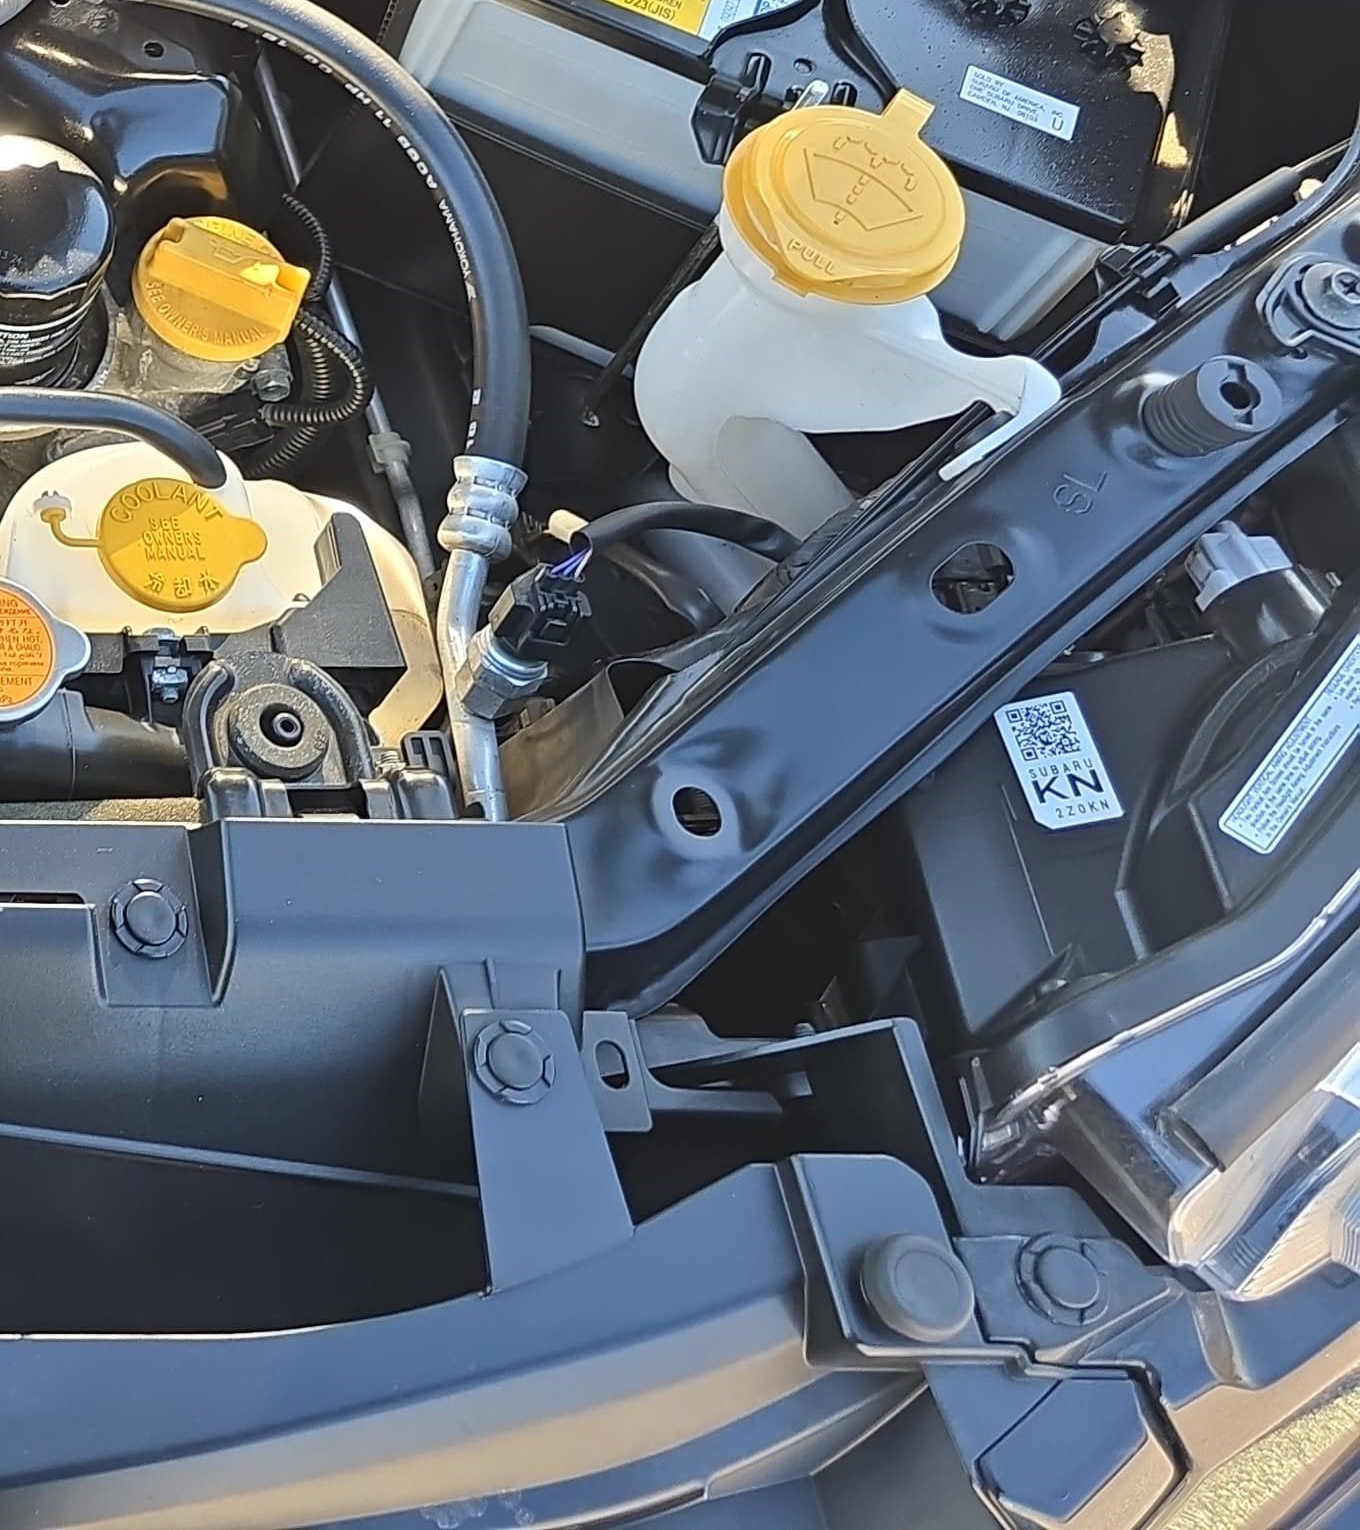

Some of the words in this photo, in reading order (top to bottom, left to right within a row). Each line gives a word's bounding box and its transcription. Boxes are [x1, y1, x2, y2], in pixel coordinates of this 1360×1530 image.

[1050, 116, 1064, 131] U
[436, 195, 473, 280] YOKOHAMA
[10, 254, 23, 265] 24
[787, 237, 840, 276] PULL
[145, 280, 163, 303] SEE
[159, 304, 208, 341] OWNER'S
[214, 326, 266, 346] MANUAL
[110, 482, 224, 523] COOLANT
[149, 517, 180, 531] SEE
[142, 530, 201, 546] OWNERS
[144, 546, 206, 561] MANUAL
[144, 570, 219, 599] 冷却水
[1028, 758, 1093, 779] SUBARU
[1031, 769, 1104, 803] KN
